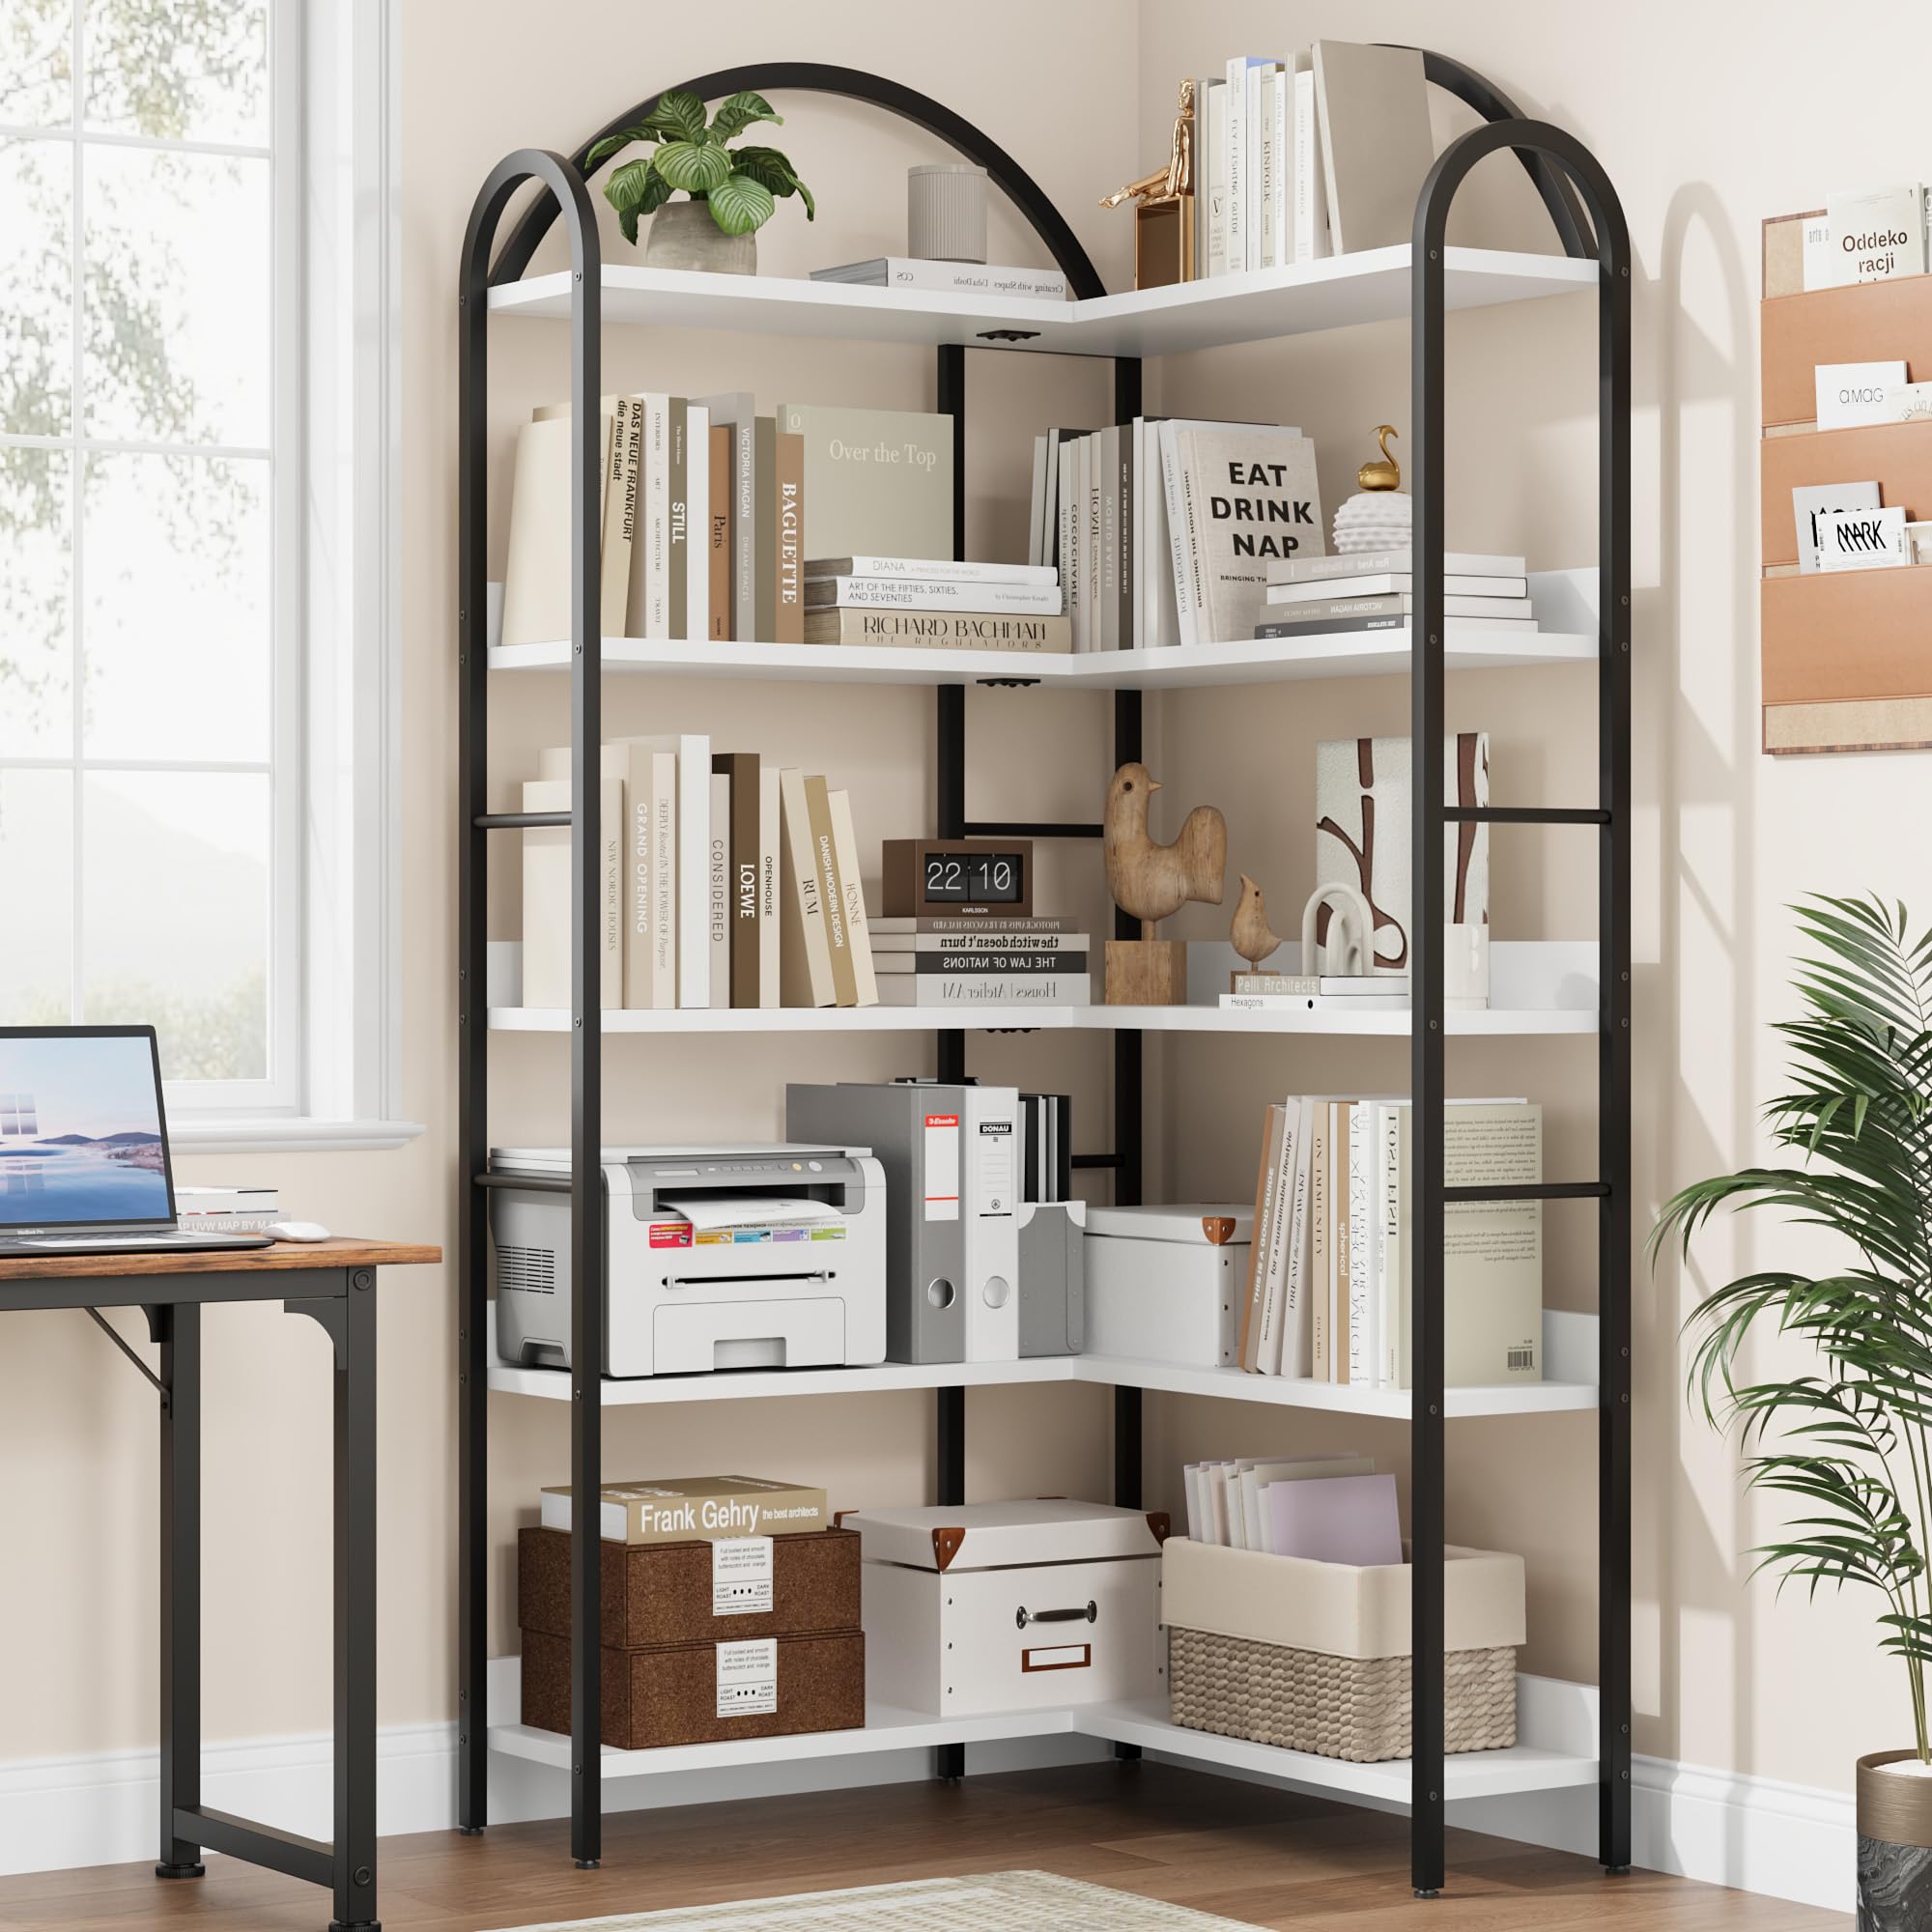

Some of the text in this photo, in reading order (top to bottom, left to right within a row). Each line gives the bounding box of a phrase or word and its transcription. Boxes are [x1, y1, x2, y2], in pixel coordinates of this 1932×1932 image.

[1842, 230, 1908, 252] Oddeko
[1859, 252, 1894, 273] racji
[612, 400, 628, 481] die neue stadt
[829, 439, 936, 471] Over the Top
[622, 403, 641, 542] DAS NEUE FRANKFURT
[741, 427, 750, 518] VICTORIA HAGAN
[1228, 462, 1287, 487] EAT
[672, 501, 685, 544] STILL
[1210, 497, 1314, 525] DRINK
[714, 515, 726, 549] Paris
[781, 482, 797, 604] BAGUETTE
[1232, 533, 1299, 558] NAP
[1836, 520, 1887, 553] MARK
[849, 582, 959, 595] ART OF THE FIFTIES, SIXTIES,
[849, 592, 912, 603] AND SEVENTIES
[1193, 558, 1203, 608] BRINGING
[864, 615, 1045, 640] RICHARD BACHMAN
[659, 798, 668, 831] DEEPLY
[659, 832, 668, 859] Rooted
[637, 803, 647, 934] GRAND OPENING
[659, 872, 668, 889] THE
[927, 862, 1010, 891] 22 10
[712, 839, 724, 942] CONSIDERED
[740, 864, 754, 919] LOEWE
[764, 856, 773, 917] OPENHOUSE
[802, 878, 819, 916] RUM
[819, 835, 843, 948] DANISH MODERN DESIGN
[659, 891, 668, 921] POWER
[845, 882, 862, 926] HONNE
[659, 923, 668, 935] OF
[1236, 978, 1317, 994] Pelli Architects
[1231, 997, 1264, 1009] Hexagons
[982, 1124, 1009, 1133] DONAU
[1316, 1138, 1322, 1159] ON
[1274, 1179, 1288, 1246] sustainable
[1282, 1130, 1293, 1177] lifestyle
[217, 1220, 240, 1231] MAP
[242, 1220, 254, 1230] BY
[1253, 1166, 1275, 1304] THIS IS A GOOD GUIDE
[1289, 1261, 1298, 1309] DREAM
[1295, 1169, 1305, 1218] AWAKE
[1339, 1221, 1349, 1276] spherical
[640, 1498, 819, 1534] Frank Gehry the best architects
